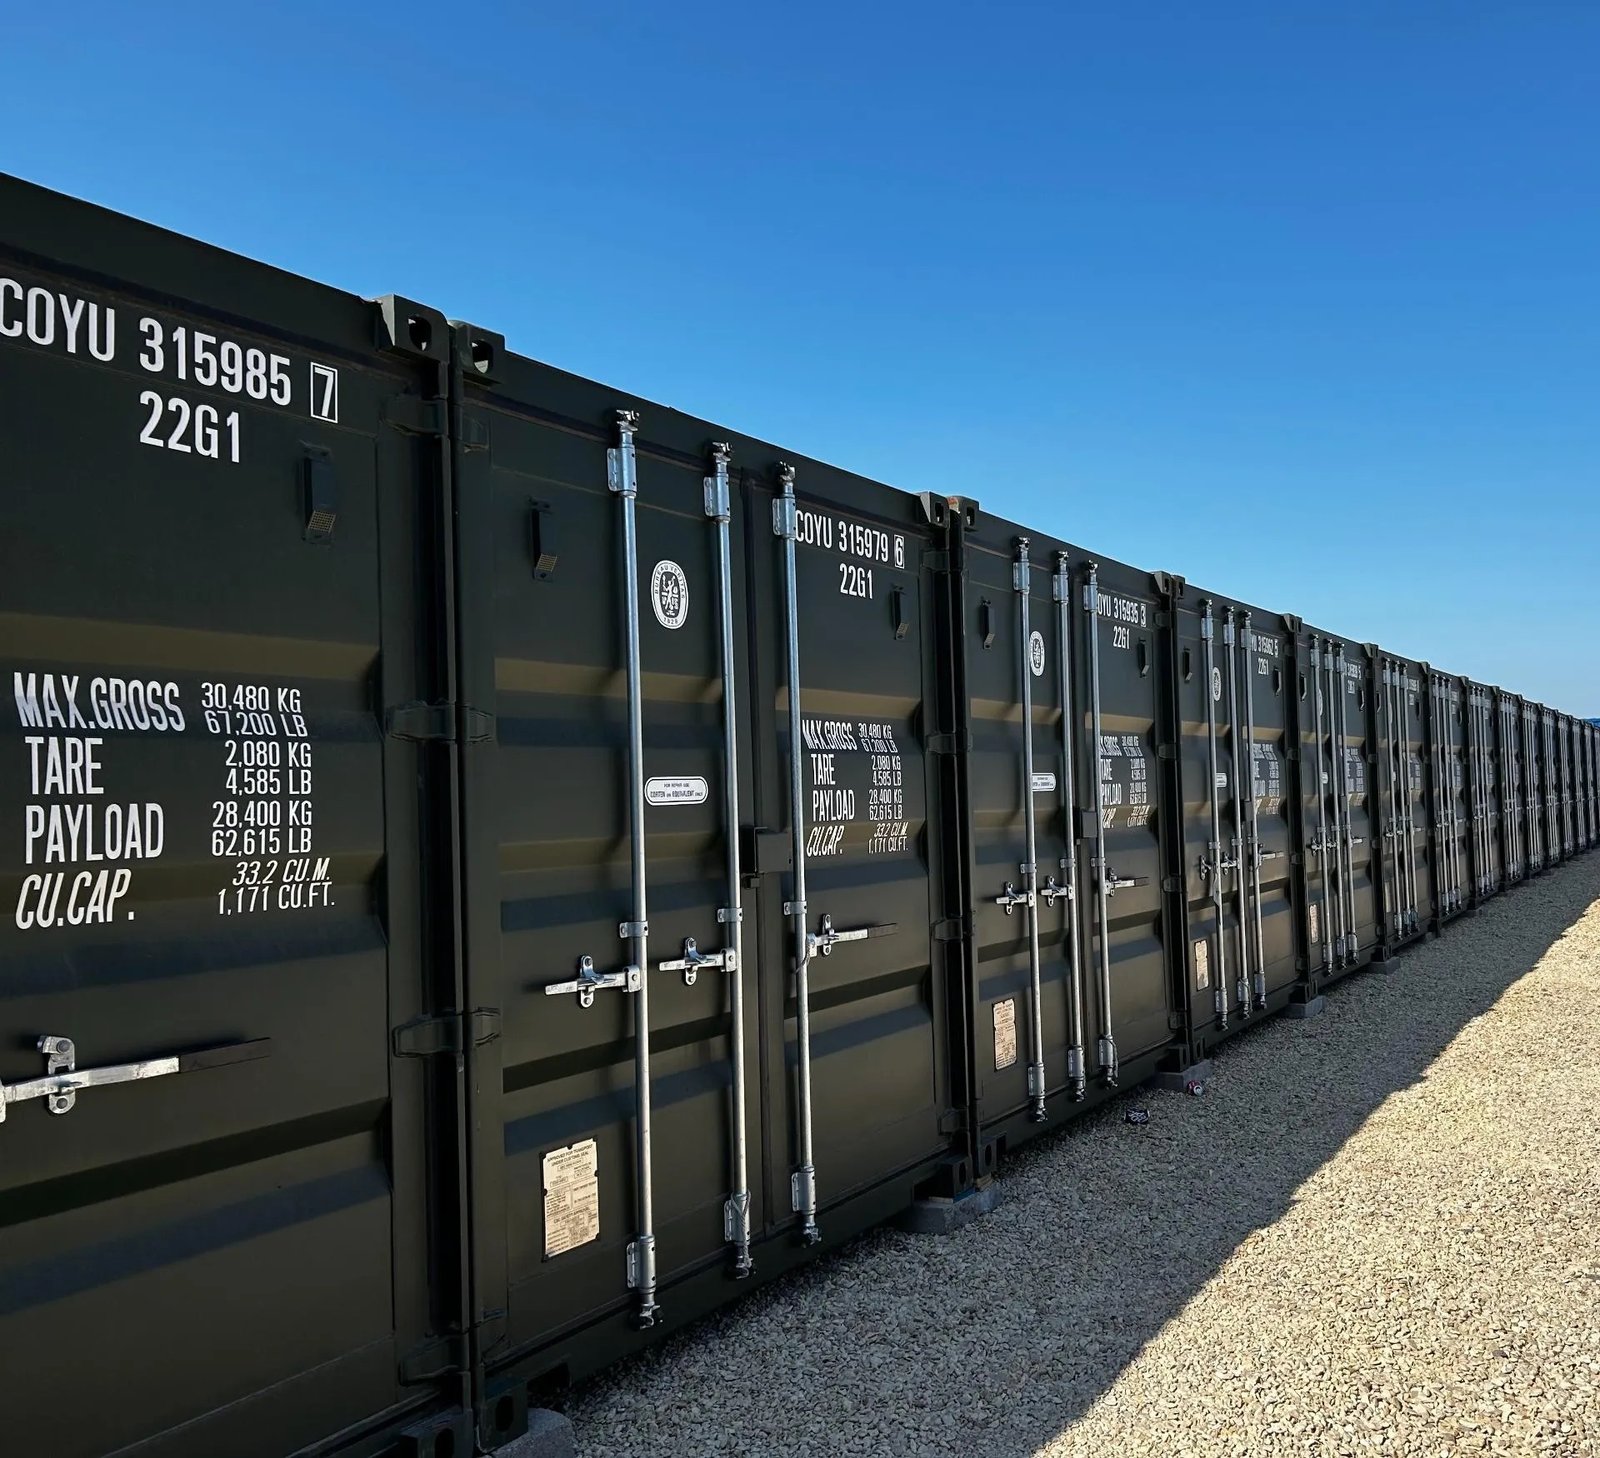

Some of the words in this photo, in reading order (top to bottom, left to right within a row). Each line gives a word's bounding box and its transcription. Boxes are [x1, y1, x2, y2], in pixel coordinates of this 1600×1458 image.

[0, 278, 115, 361] COYU
[139, 317, 291, 406] 315985
[139, 390, 240, 463] 22G1
[795, 509, 832, 549] COYU
[838, 520, 889, 562] 315979
[840, 563, 873, 599] 22G1
[1097, 593, 1111, 617] OYU
[13, 672, 186, 732] MAX.GROSS
[201, 682, 270, 712] 30,480
[277, 687, 302, 713] KG
[204, 710, 277, 737] 67,200
[280, 713, 308, 737] LB
[802, 719, 857, 751] MAX.GROSS
[882, 724, 892, 740] KG
[25, 736, 104, 795] TARE
[225, 740, 281, 768] 2,080
[288, 744, 312, 768] KG
[225, 768, 281, 796] 4,585
[288, 769, 312, 795] LB
[810, 753, 836, 786] TARE
[891, 755, 902, 771] KG
[892, 771, 902, 786] LB
[813, 789, 855, 821] PAYLOAD
[893, 788, 903, 804] KG
[893, 804, 903, 820] LB
[25, 802, 164, 865] PAYLOAD
[212, 800, 281, 829] 28,400
[288, 800, 313, 826] KG
[211, 828, 281, 858] 62,615
[288, 827, 312, 854] LB
[15, 868, 135, 931] CU.CAP.
[232, 860, 279, 887] 33.2
[282, 857, 331, 884] CU.M.
[218, 886, 271, 916] 1,171
[278, 882, 336, 911] CU.FT.
